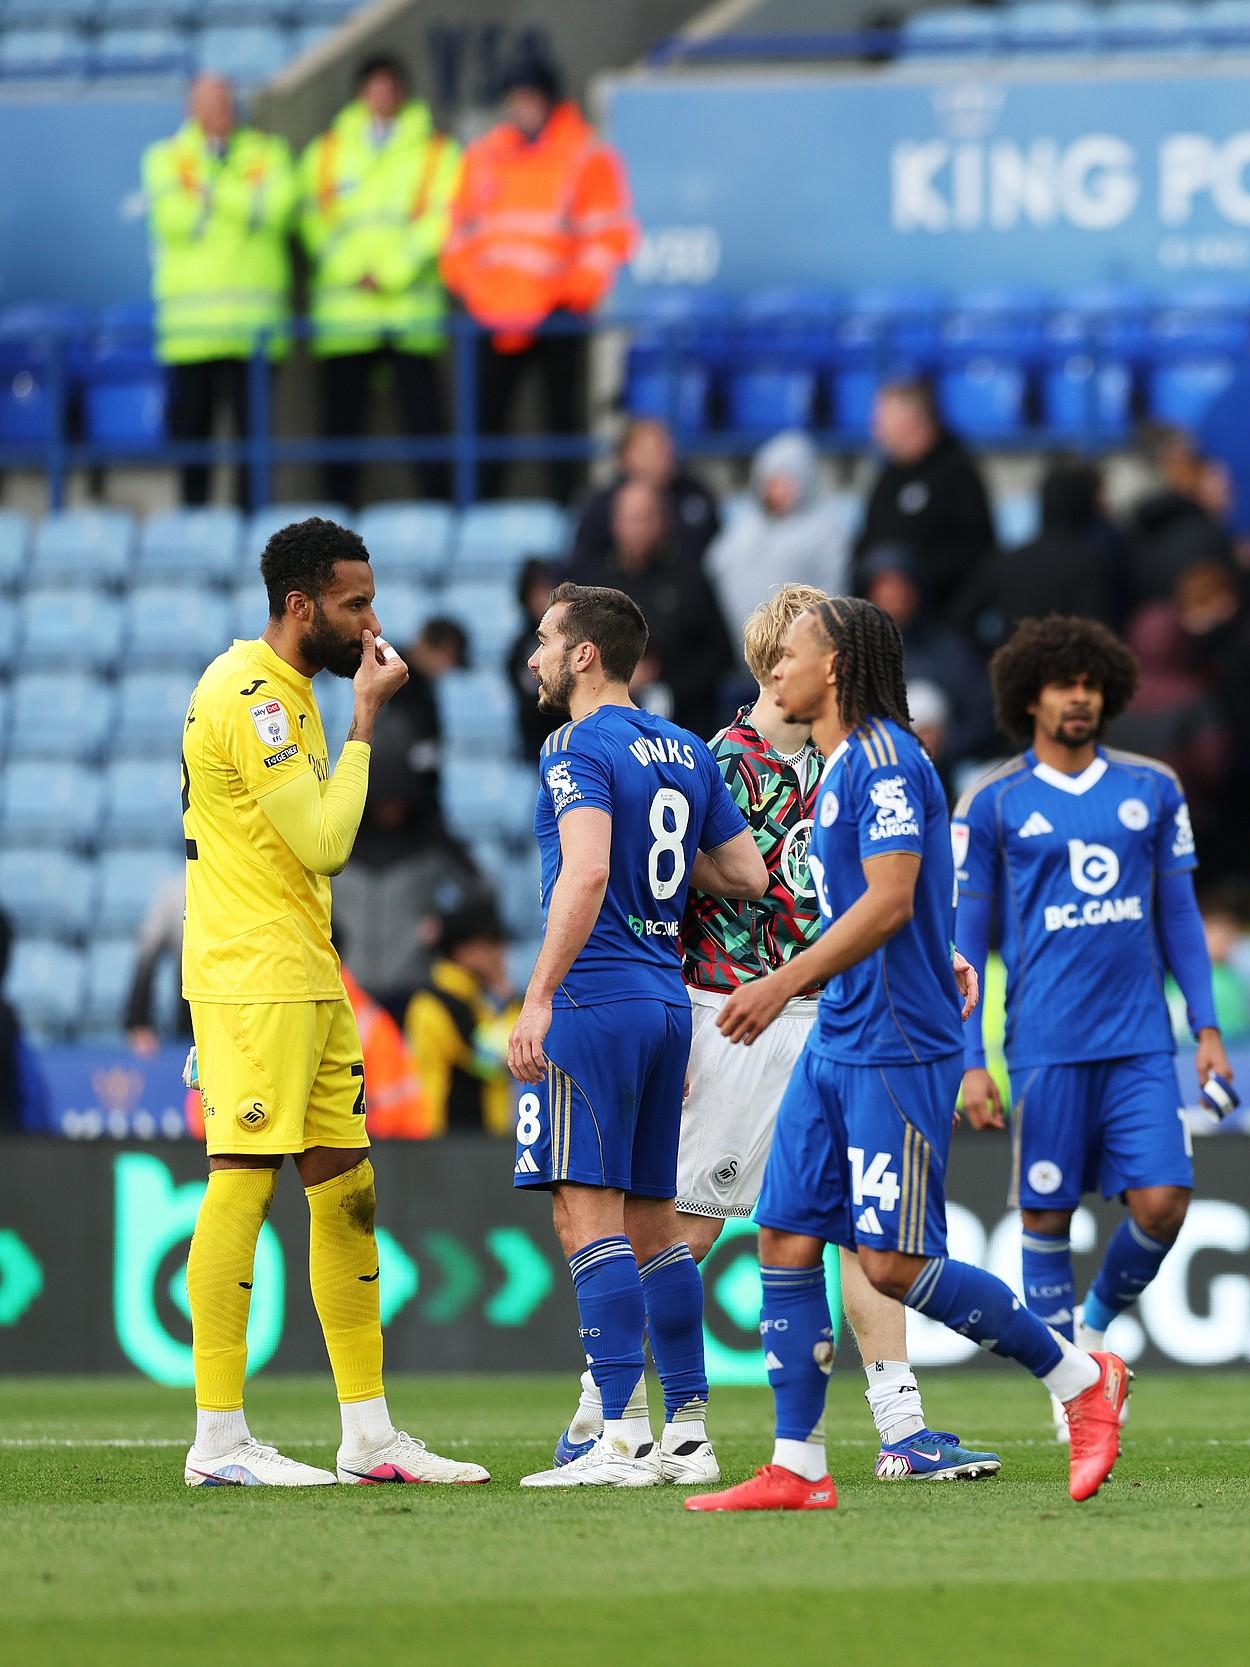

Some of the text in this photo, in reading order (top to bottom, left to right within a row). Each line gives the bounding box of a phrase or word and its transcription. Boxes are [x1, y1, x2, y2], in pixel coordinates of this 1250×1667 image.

[891, 134, 1138, 231] KING
[758, 773, 769, 794] 17
[648, 787, 690, 900] 8
[1044, 896, 1143, 931] BC.GAME
[516, 1092, 541, 1146] 8
[848, 1147, 900, 1211] 14
